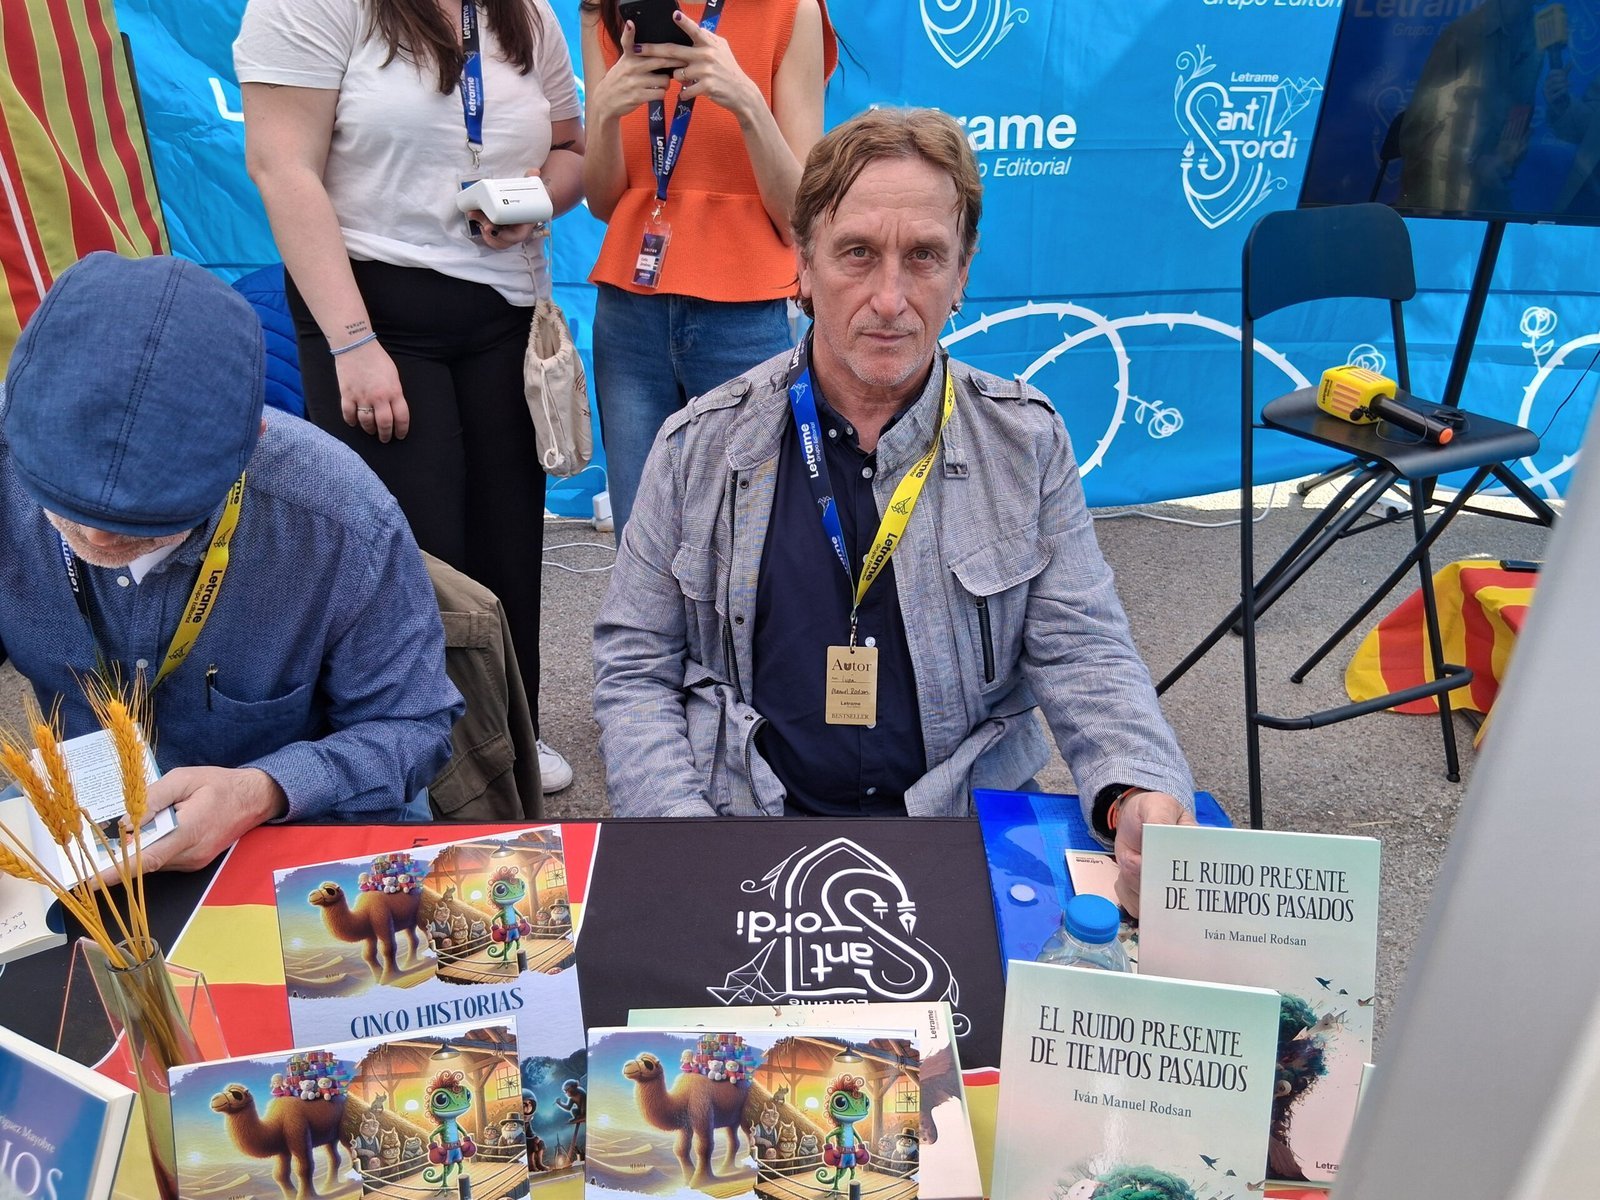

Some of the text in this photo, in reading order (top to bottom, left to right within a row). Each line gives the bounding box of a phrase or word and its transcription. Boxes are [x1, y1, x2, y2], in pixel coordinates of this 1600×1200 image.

[463, 4, 471, 39] Letrame
[1230, 71, 1279, 82] Letrame
[467, 76, 476, 116] Letrame
[662, 134, 678, 175] Letrame
[993, 156, 1072, 177] Editorial
[801, 423, 819, 479] Letrame
[866, 532, 898, 582] Letrame
[192, 569, 223, 624] Letrame
[832, 658, 872, 672] Autor
[1172, 859, 1349, 894] EL RUIDO PRESENTE
[1165, 886, 1354, 922] DE TIEMPOS PASADOS
[1204, 928, 1307, 946] Iván Manuel Rodsan
[350, 987, 525, 1040] CINCO HISTORIAS
[927, 1009, 938, 1039] Letrame
[1039, 1005, 1243, 1058] EL RUIDO PRESENTE
[1029, 1035, 1248, 1093] DE TIEMPOS PASADOS
[1073, 1089, 1192, 1118] Iván Manuel Rodsan
[1315, 1161, 1340, 1171] Letra
